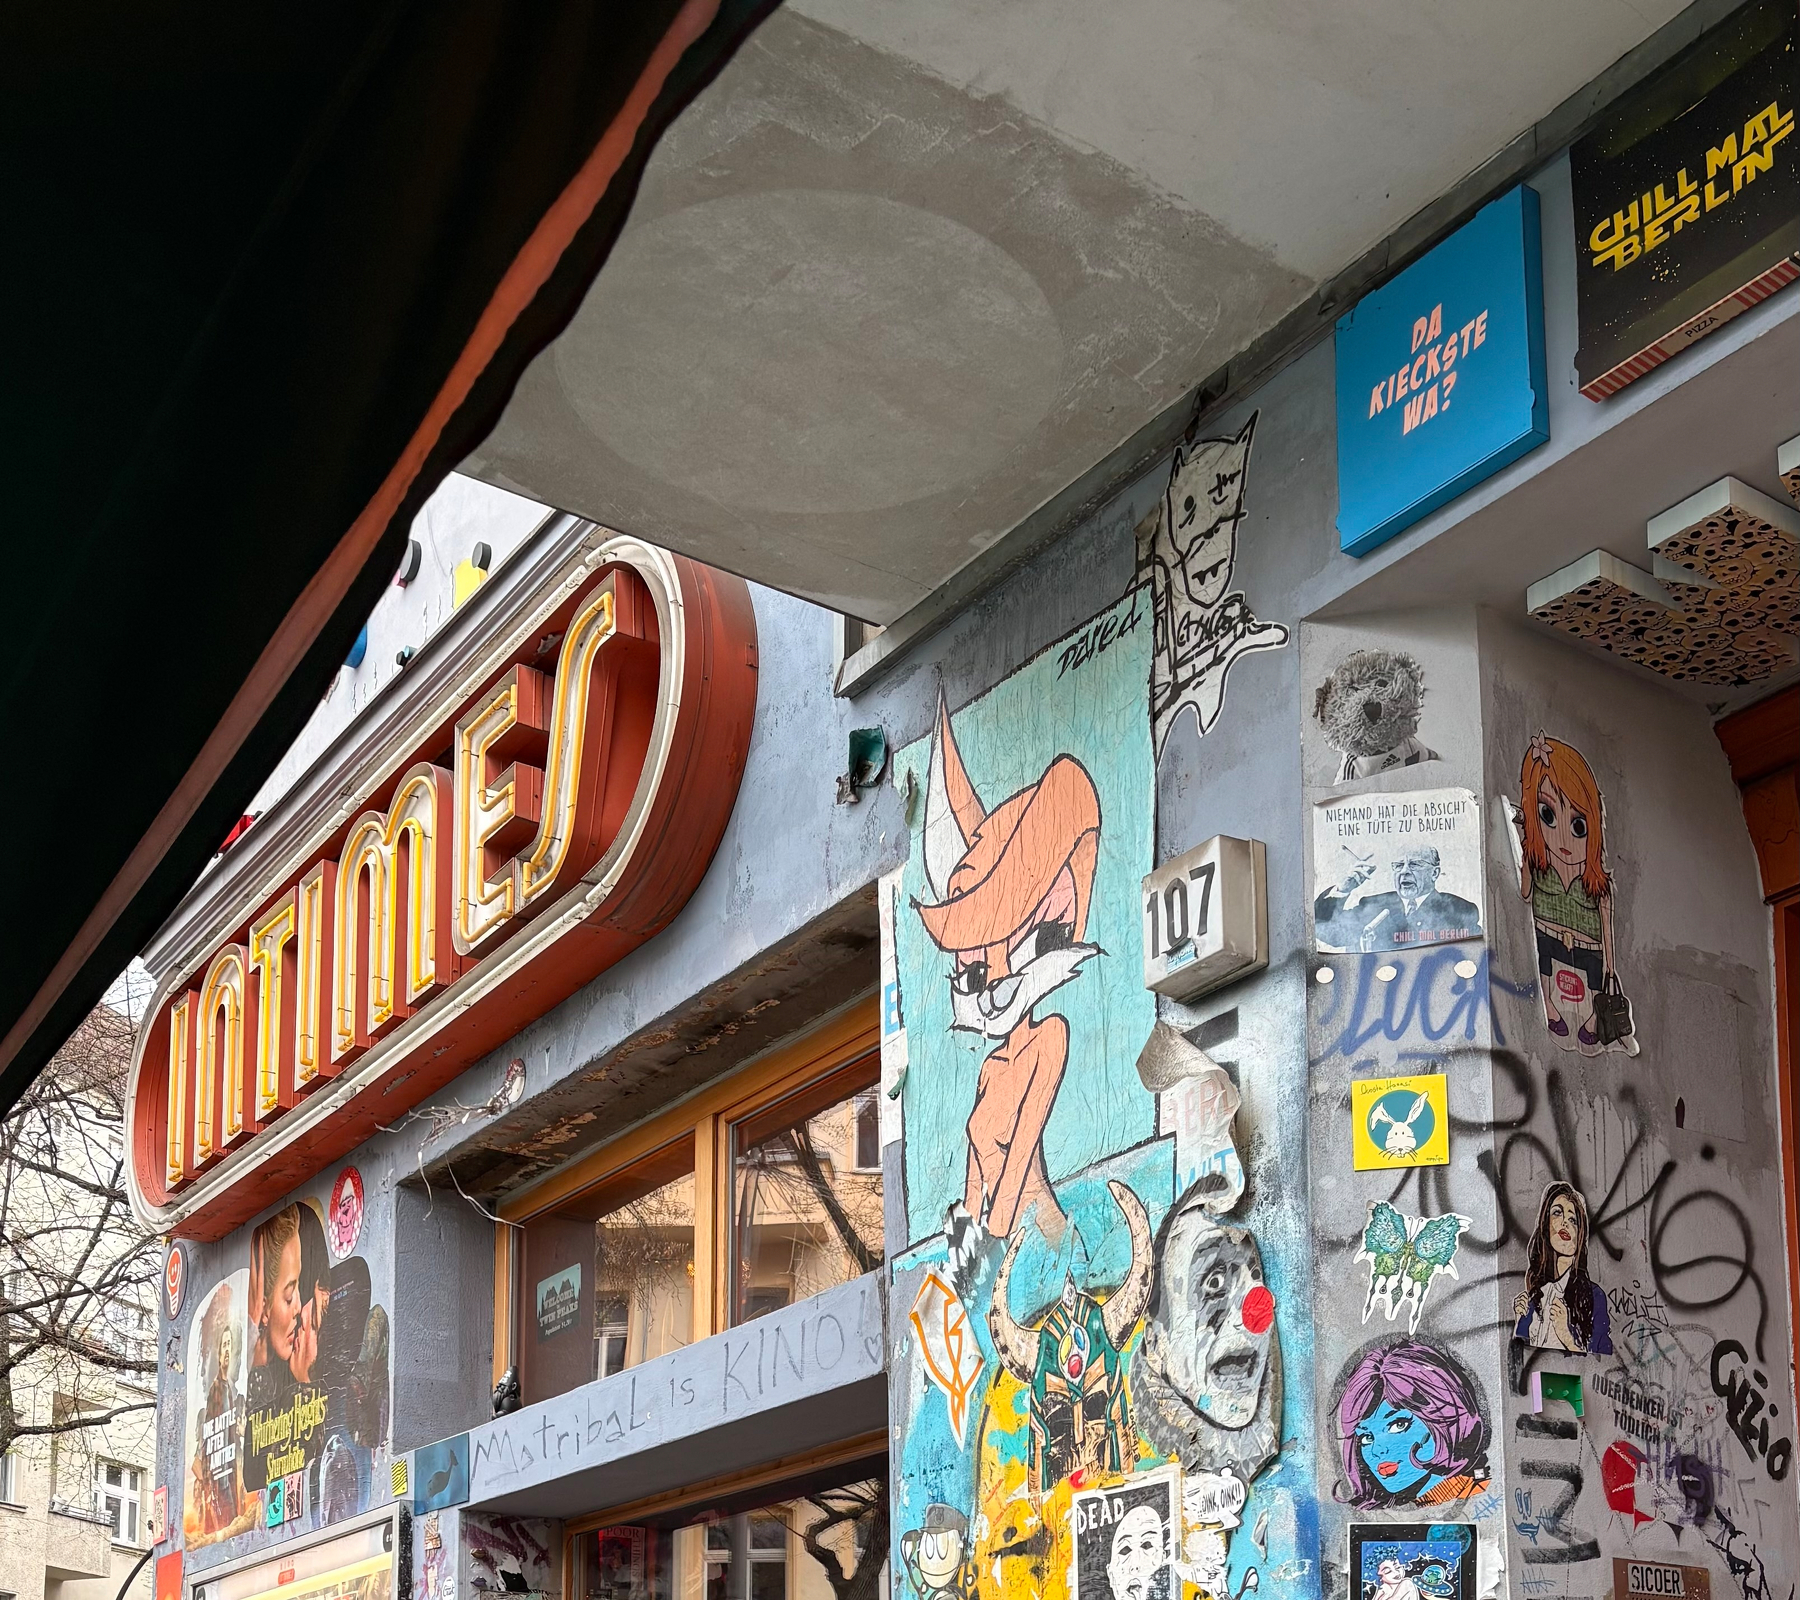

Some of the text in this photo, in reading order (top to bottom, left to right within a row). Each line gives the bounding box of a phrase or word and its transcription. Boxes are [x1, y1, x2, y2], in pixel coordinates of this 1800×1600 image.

[1590, 101, 1795, 252] CHILL MAL
[1592, 122, 1796, 272] BERLIN
[1411, 303, 1442, 355] DA
[1684, 315, 1718, 338] PIZZA
[1368, 309, 1489, 420] KIECKSTE
[1403, 371, 1457, 436] WA?
[1326, 800, 1467, 823] NIEMAND HAT DIE ABSICHT
[1338, 817, 1456, 836] EINE TÜTE ZU BAUEN!
[1146, 861, 1215, 960] 107
[1393, 927, 1470, 942] CHILL MAL BERLIN
[669, 1358, 697, 1408] is
[606, 1527, 640, 1538] POOR
[1077, 1497, 1125, 1535] DEAD
[632, 1540, 641, 1577] THINGS
[1631, 1565, 1682, 1595] SICOER
